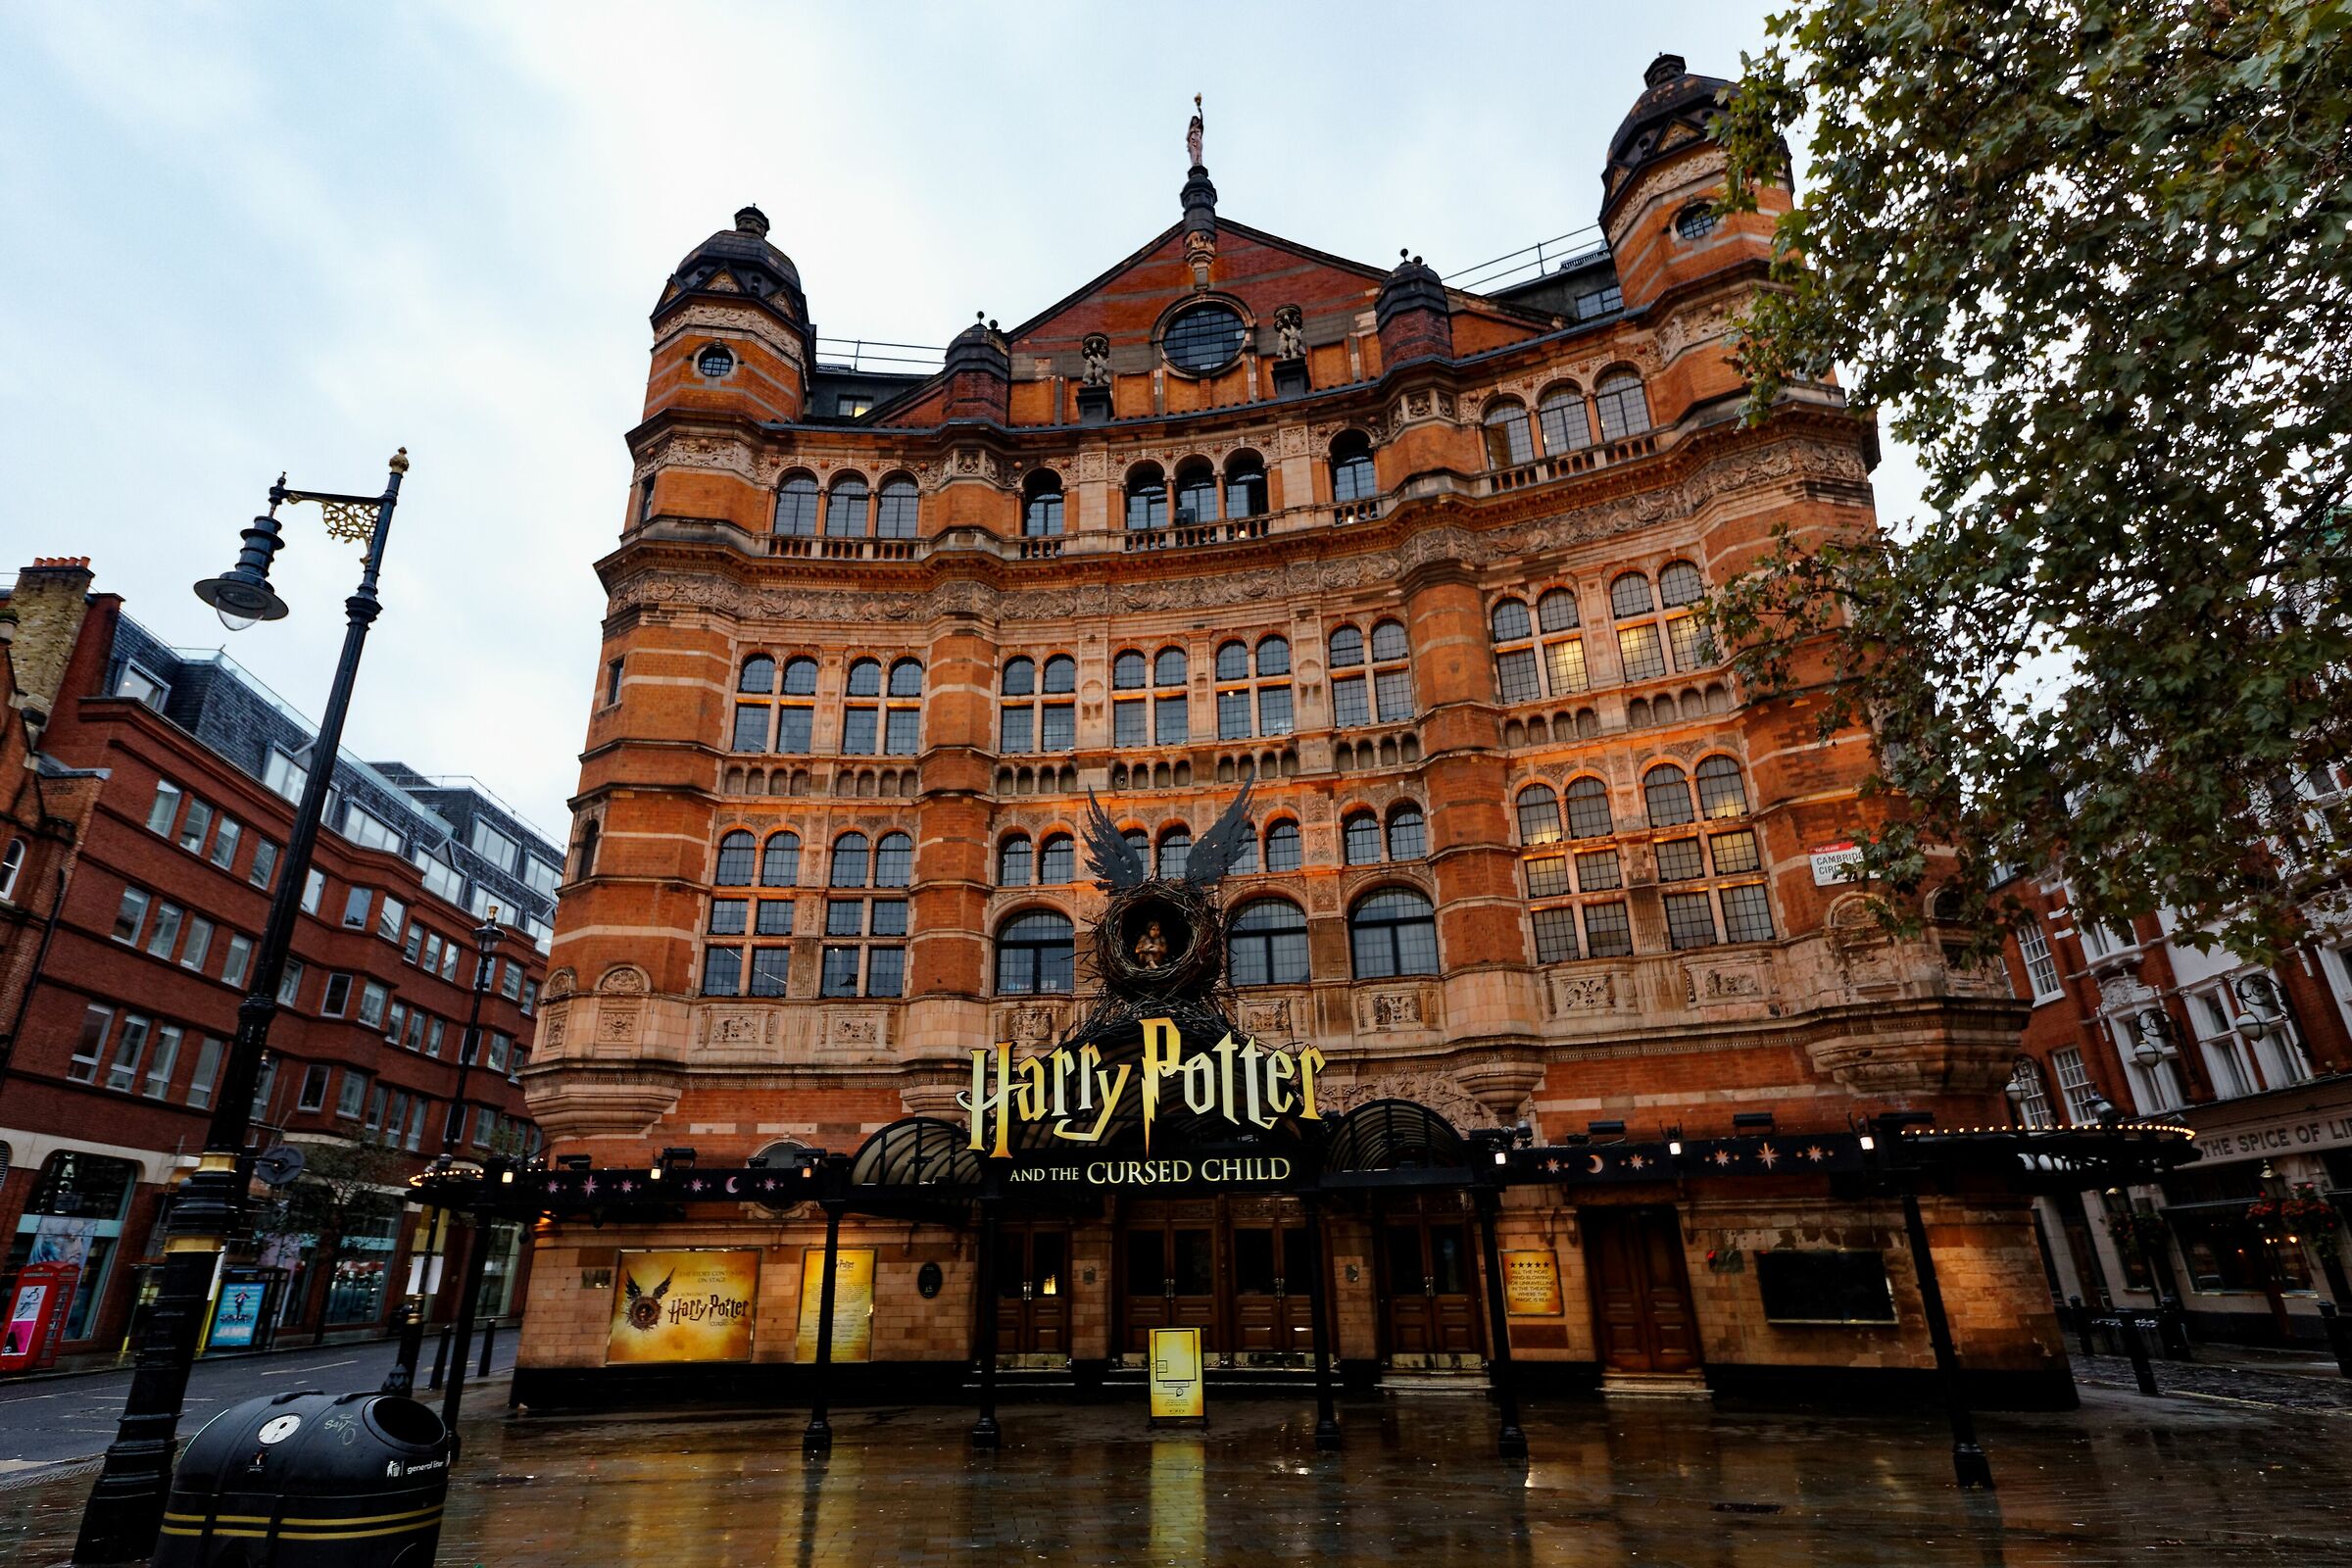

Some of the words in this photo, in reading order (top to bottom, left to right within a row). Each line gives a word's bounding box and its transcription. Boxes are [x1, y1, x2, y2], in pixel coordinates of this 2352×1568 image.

[956, 1041, 1131, 1158] Harry
[1138, 1017, 1326, 1158] Potter
[2200, 1138, 2233, 1157] THE
[2238, 1128, 2291, 1152] SPICE
[2295, 1122, 2320, 1144] OF
[1010, 1169, 1046, 1182] AND
[1049, 1168, 1079, 1182] THE
[1087, 1160, 1193, 1186] CURSED
[1200, 1157, 1291, 1182] CHILD
[667, 1298, 708, 1325] Harry
[709, 1295, 749, 1321] Potter
[407, 1461, 432, 1475] general
